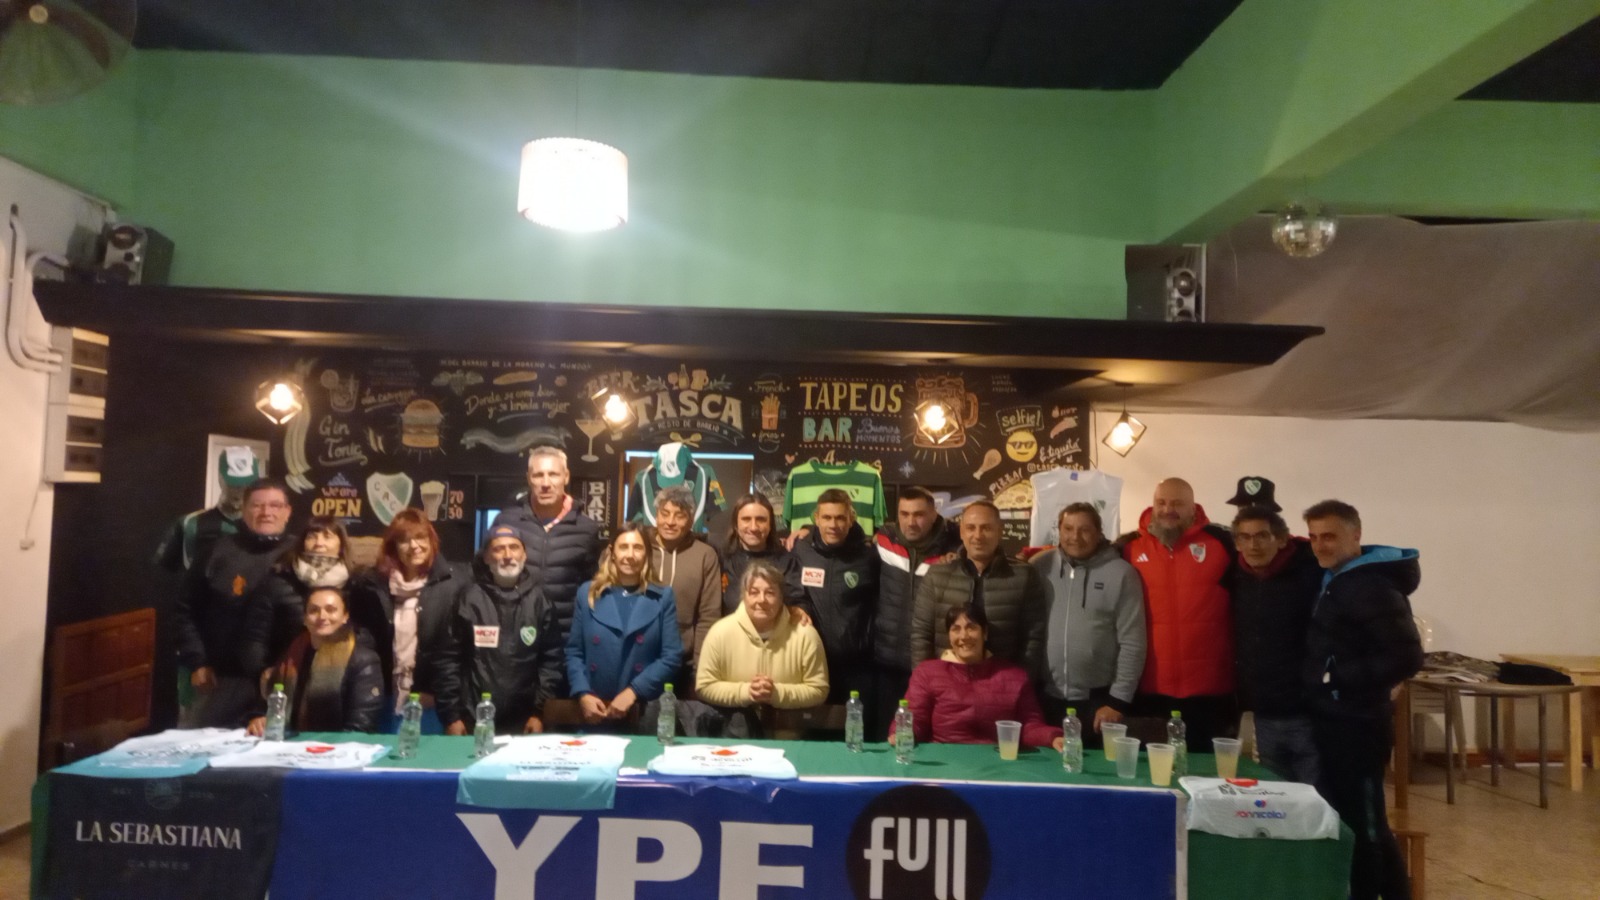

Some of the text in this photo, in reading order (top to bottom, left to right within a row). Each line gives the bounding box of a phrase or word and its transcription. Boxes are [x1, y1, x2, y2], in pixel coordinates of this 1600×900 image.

[629, 390, 743, 431] TASCA
[799, 381, 904, 413] TAPEOS
[319, 414, 350, 436] Gin
[802, 417, 853, 443] BAR
[325, 437, 362, 458] Tonic
[311, 498, 362, 517] OPEN
[449, 490, 464, 504] 70
[586, 481, 606, 521] BAR
[76, 820, 242, 851] LA SEBASTIANA
[455, 812, 813, 900] YPF
